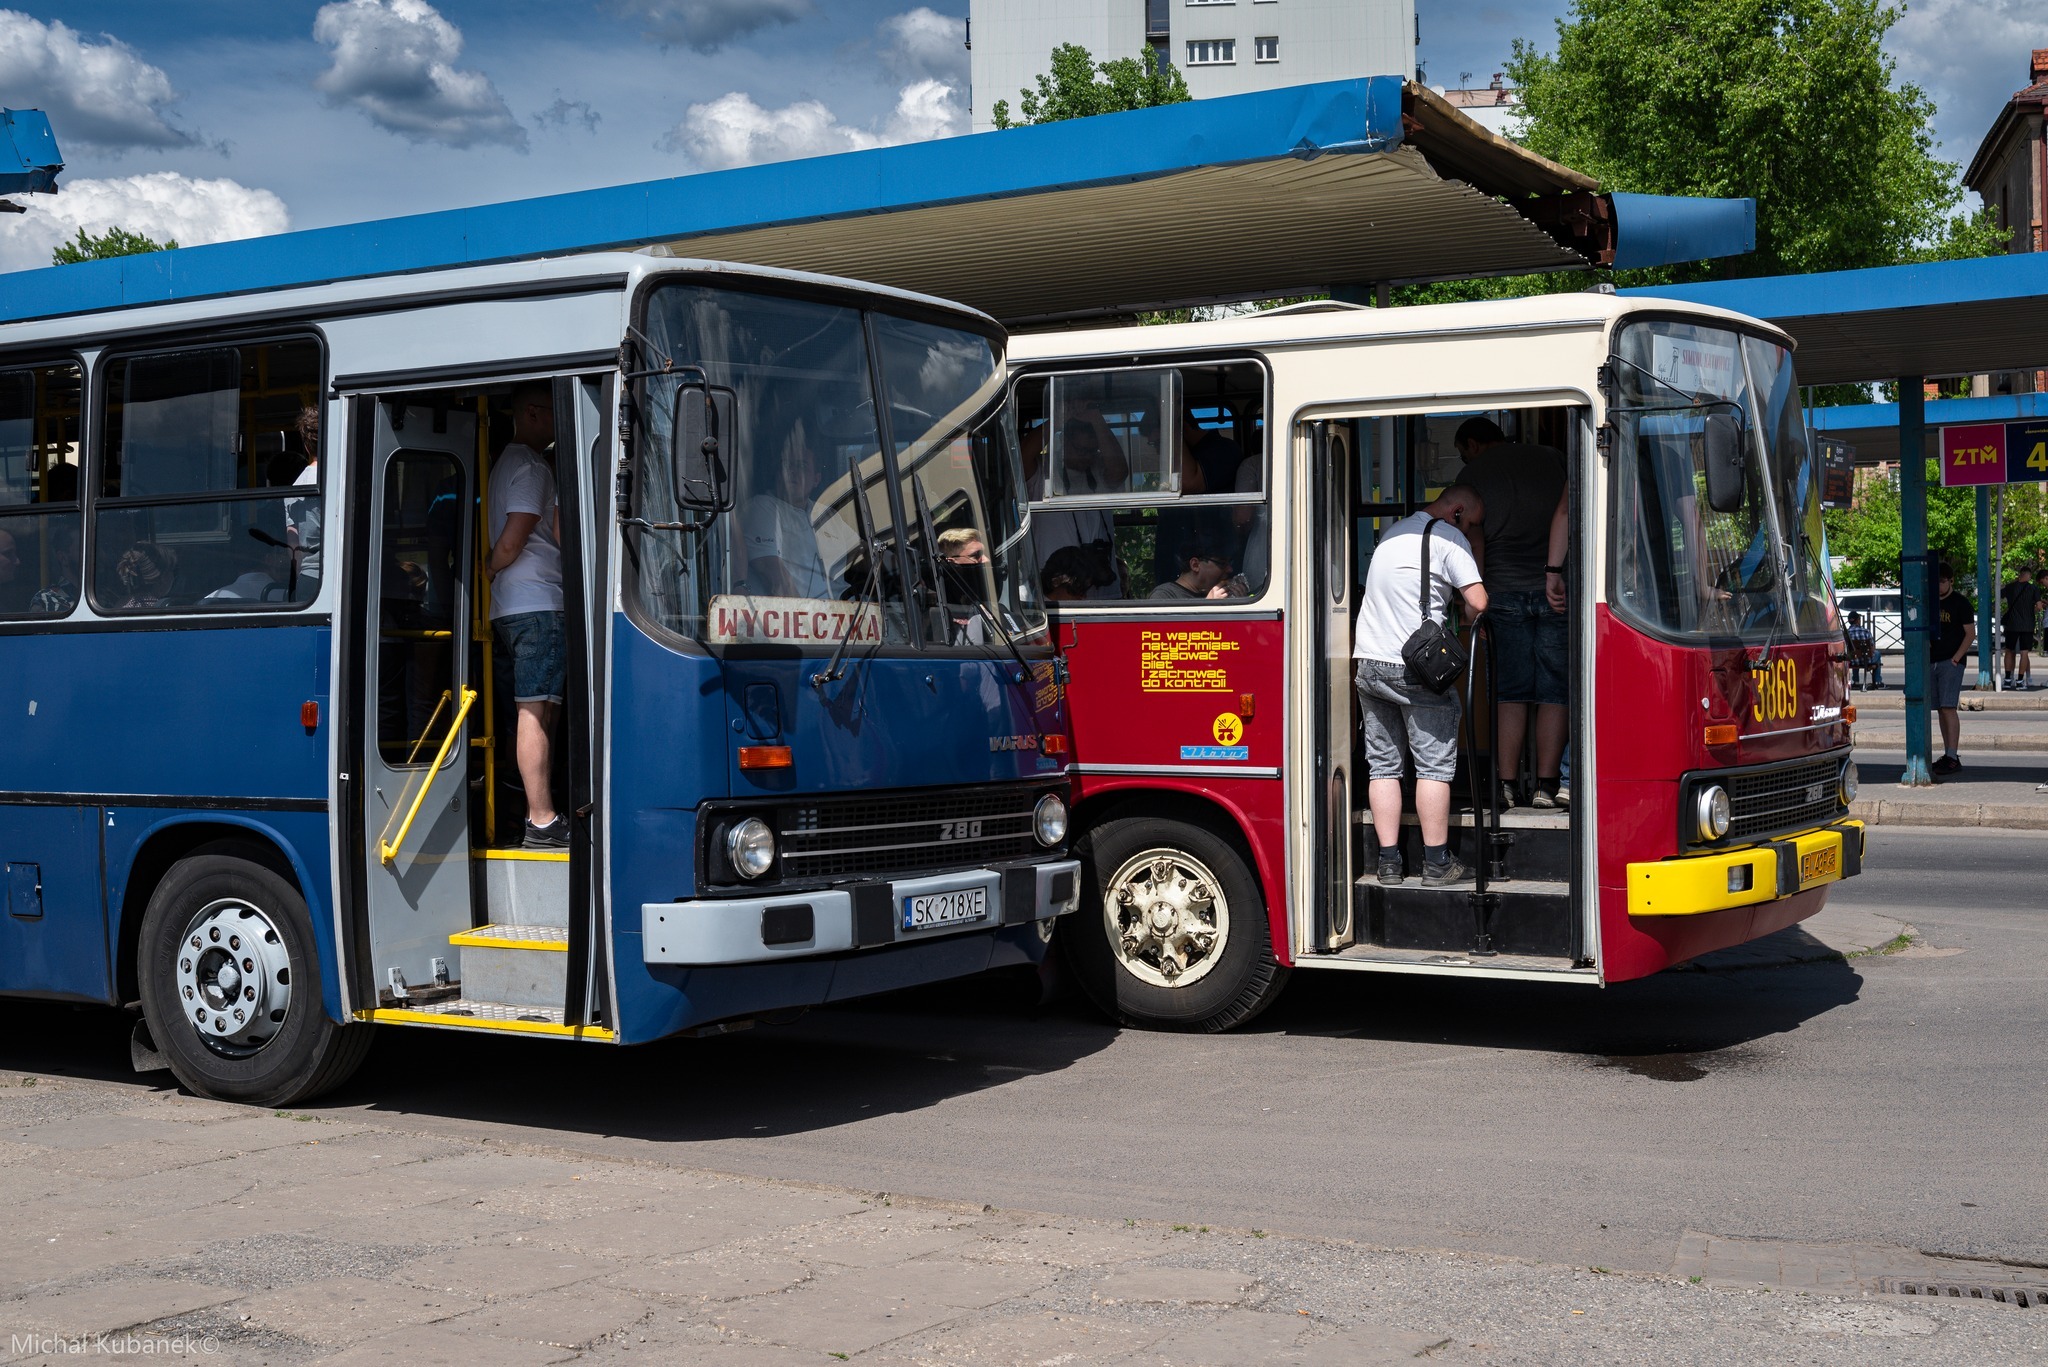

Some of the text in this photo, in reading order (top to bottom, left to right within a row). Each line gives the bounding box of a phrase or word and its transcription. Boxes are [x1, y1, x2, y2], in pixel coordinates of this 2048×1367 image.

[1953, 445, 1997, 466] ZTM
[2026, 441, 2048, 472] 4
[718, 608, 881, 641] WYCIECZKA
[1142, 631, 1161, 641] Po
[1142, 641, 1240, 653] natychmiast
[1142, 651, 1218, 660] skasować
[1142, 661, 1174, 669] bilet
[1149, 669, 1226, 678] zachować
[1142, 679, 1226, 687] do kontroli
[1752, 658, 1797, 722] 3869
[989, 735, 1038, 752] IKARUS
[915, 891, 982, 923] SK 218XE
